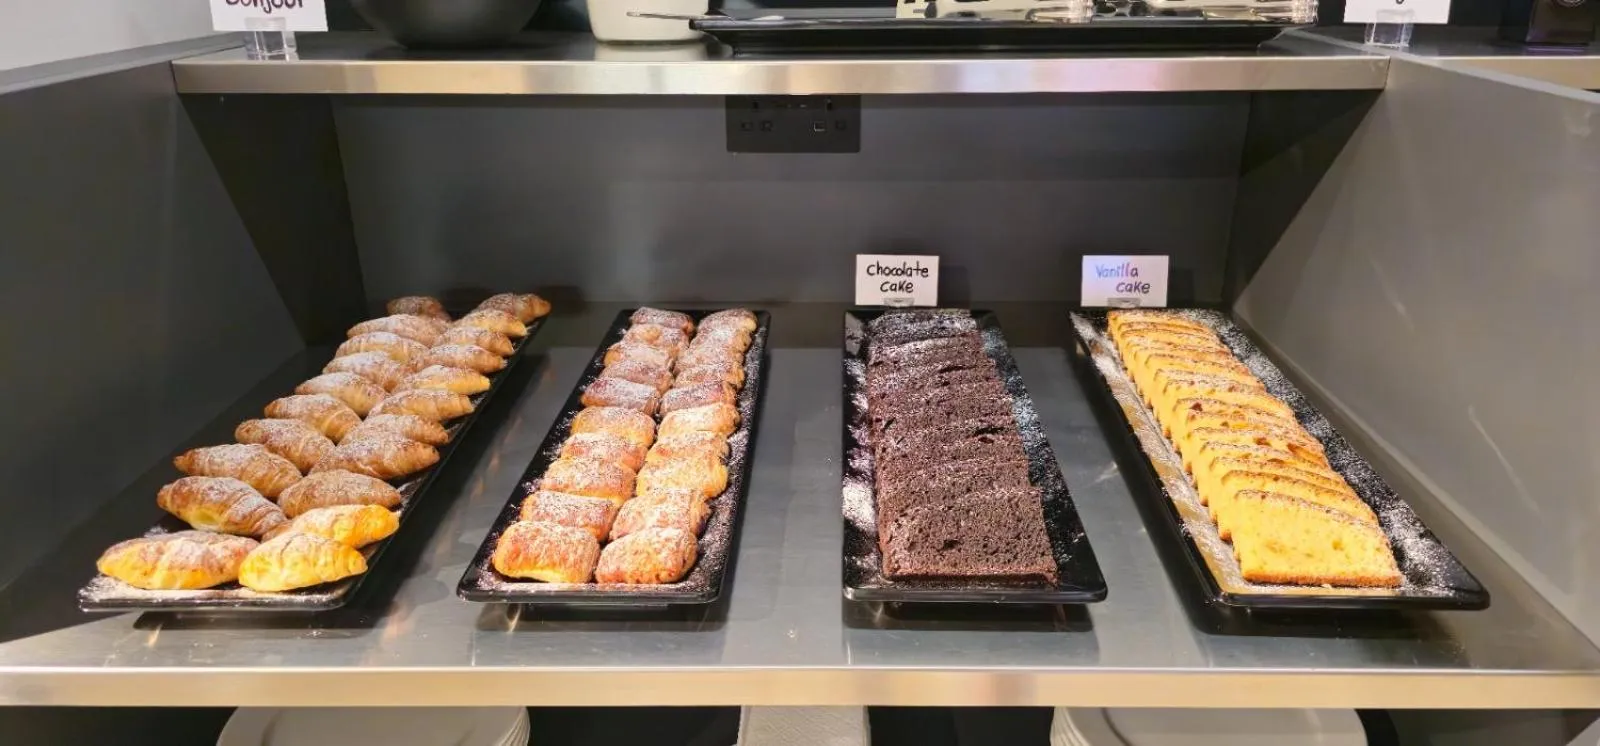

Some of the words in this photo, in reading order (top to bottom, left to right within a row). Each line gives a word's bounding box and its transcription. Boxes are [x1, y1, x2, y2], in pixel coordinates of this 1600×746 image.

[1095, 261, 1139, 278] Vanilla
[880, 280, 914, 294] cake
[1115, 280, 1151, 294] cake
